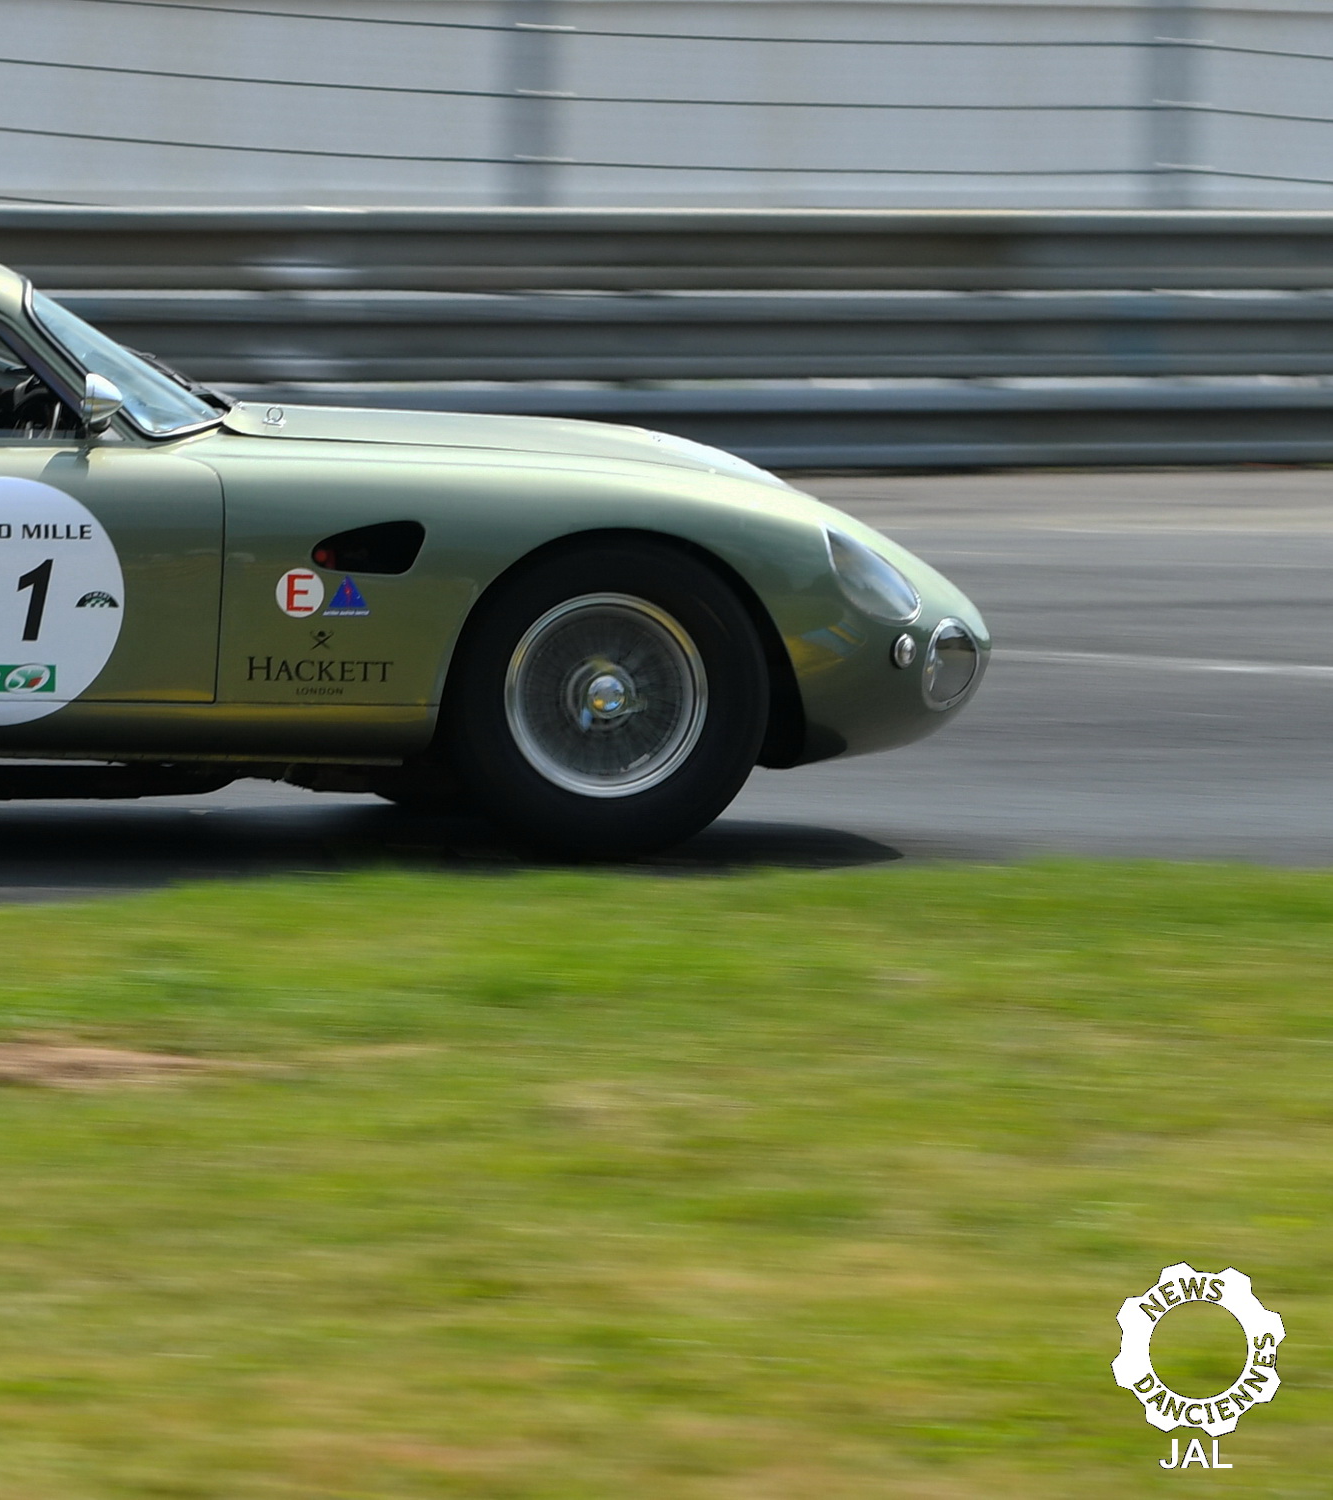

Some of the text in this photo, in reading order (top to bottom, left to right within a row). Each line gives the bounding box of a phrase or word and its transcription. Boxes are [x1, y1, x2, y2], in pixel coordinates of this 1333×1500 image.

[22, 524, 92, 540] MILLE
[286, 574, 314, 612] E
[247, 656, 394, 682] HACKETT
[296, 687, 343, 695] LONDON
